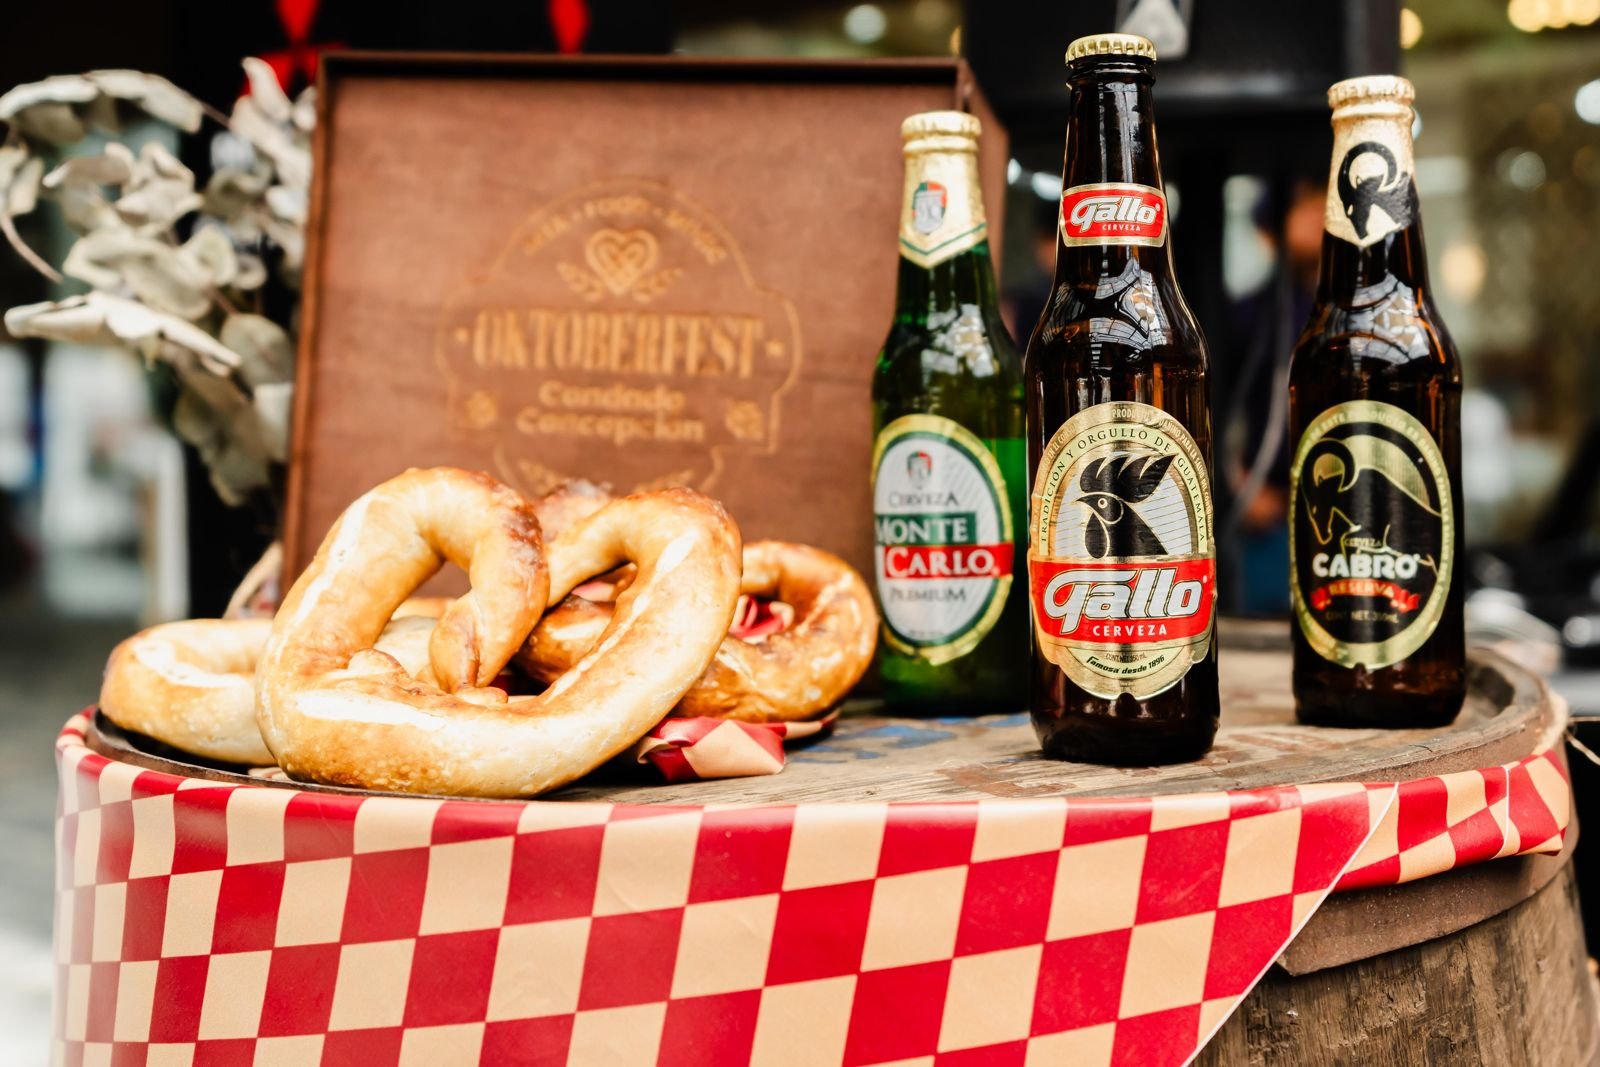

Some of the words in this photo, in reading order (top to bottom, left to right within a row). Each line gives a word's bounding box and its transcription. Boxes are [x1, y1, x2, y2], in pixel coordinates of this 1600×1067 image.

[1102, 224, 1141, 232] CERVEZA
[472, 309, 764, 378] OKTOBERFEST
[539, 380, 686, 413] Condado
[1180, 433, 1192, 451] PARA
[1189, 449, 1199, 461] LA
[1041, 461, 1066, 542] TRADICIÓN
[1066, 448, 1074, 459] Y
[1077, 427, 1148, 450] ORGULLO
[1154, 436, 1172, 453] DE
[1177, 457, 1205, 542] GUATEMALA
[889, 491, 959, 507] CERVEZA
[875, 517, 968, 544] MONTE
[886, 546, 995, 578] CARLO
[1312, 552, 1418, 579] CABRO
[890, 587, 967, 603] PREMIUM
[1328, 581, 1395, 599] RESERVA
[1092, 624, 1168, 637] CERVEZA
[1086, 656, 1120, 674] Famosa
[1121, 665, 1148, 675] desde
[1148, 654, 1165, 669] 1896
